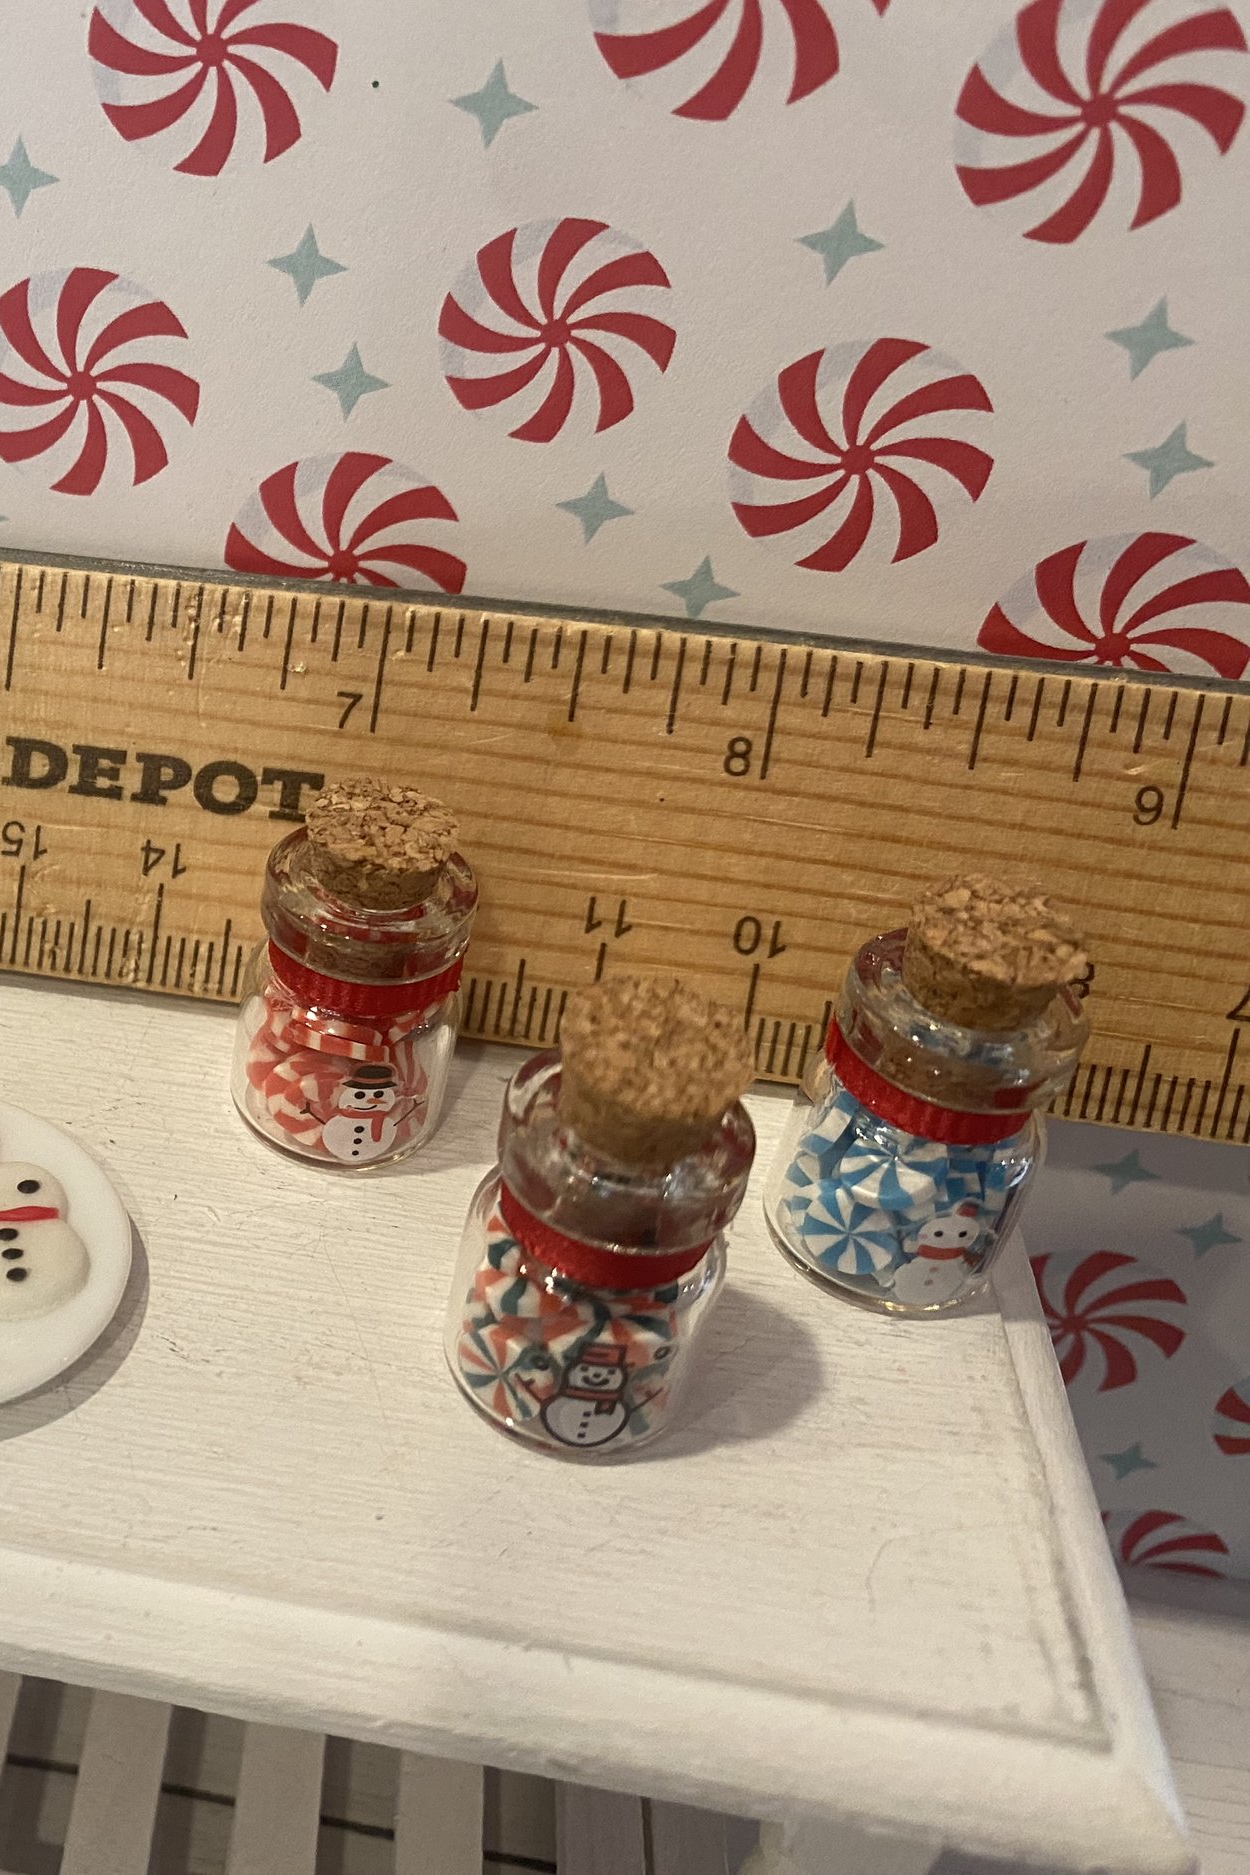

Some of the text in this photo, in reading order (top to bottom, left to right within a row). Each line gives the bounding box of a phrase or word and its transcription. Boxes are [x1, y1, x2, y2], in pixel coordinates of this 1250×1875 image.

[1, 735, 326, 824] DEPOT
[336, 691, 364, 729] 7
[723, 737, 753, 777] 8
[1132, 785, 1165, 826] 9
[0, 820, 49, 860] 15
[140, 838, 187, 880] 14
[584, 895, 633, 938] 11
[732, 915, 787, 960] 10
